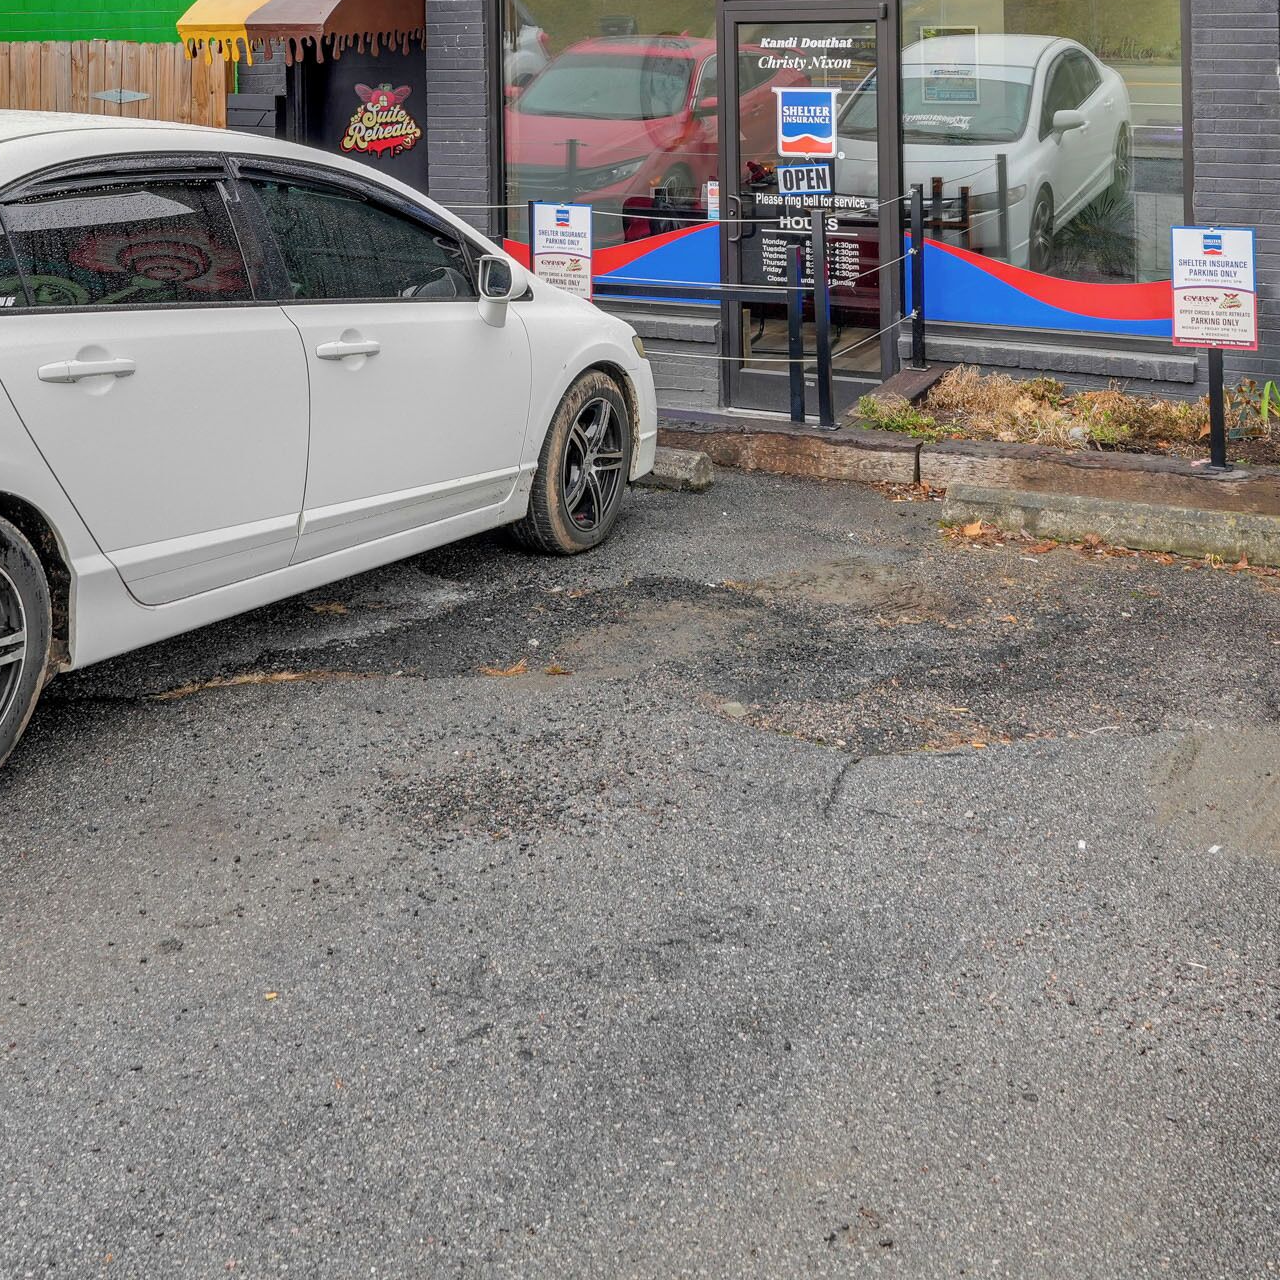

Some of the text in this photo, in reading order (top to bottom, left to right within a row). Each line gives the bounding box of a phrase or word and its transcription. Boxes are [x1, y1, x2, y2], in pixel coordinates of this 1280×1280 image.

[760, 37, 797, 49] Kandi
[800, 37, 853, 49] Douthat
[758, 56, 852, 71] Christy Nixon
[361, 102, 407, 128] Suite
[783, 106, 830, 117] SHELTER
[783, 116, 830, 124] INSURANCE
[343, 120, 420, 149] Retreats
[782, 167, 828, 191] OPEN
[755, 192, 868, 209] Please ring bell for service.
[780, 216, 838, 231] HOUS
[762, 238, 787, 246] Monday
[762, 245, 787, 253] Tuesda
[1179, 259, 1248, 269] SHELTER INSURANCE
[1189, 268, 1238, 278] PARKING ONLY
[4, 296, 16, 307] AF
[1191, 317, 1239, 326] PARKING ONLY
